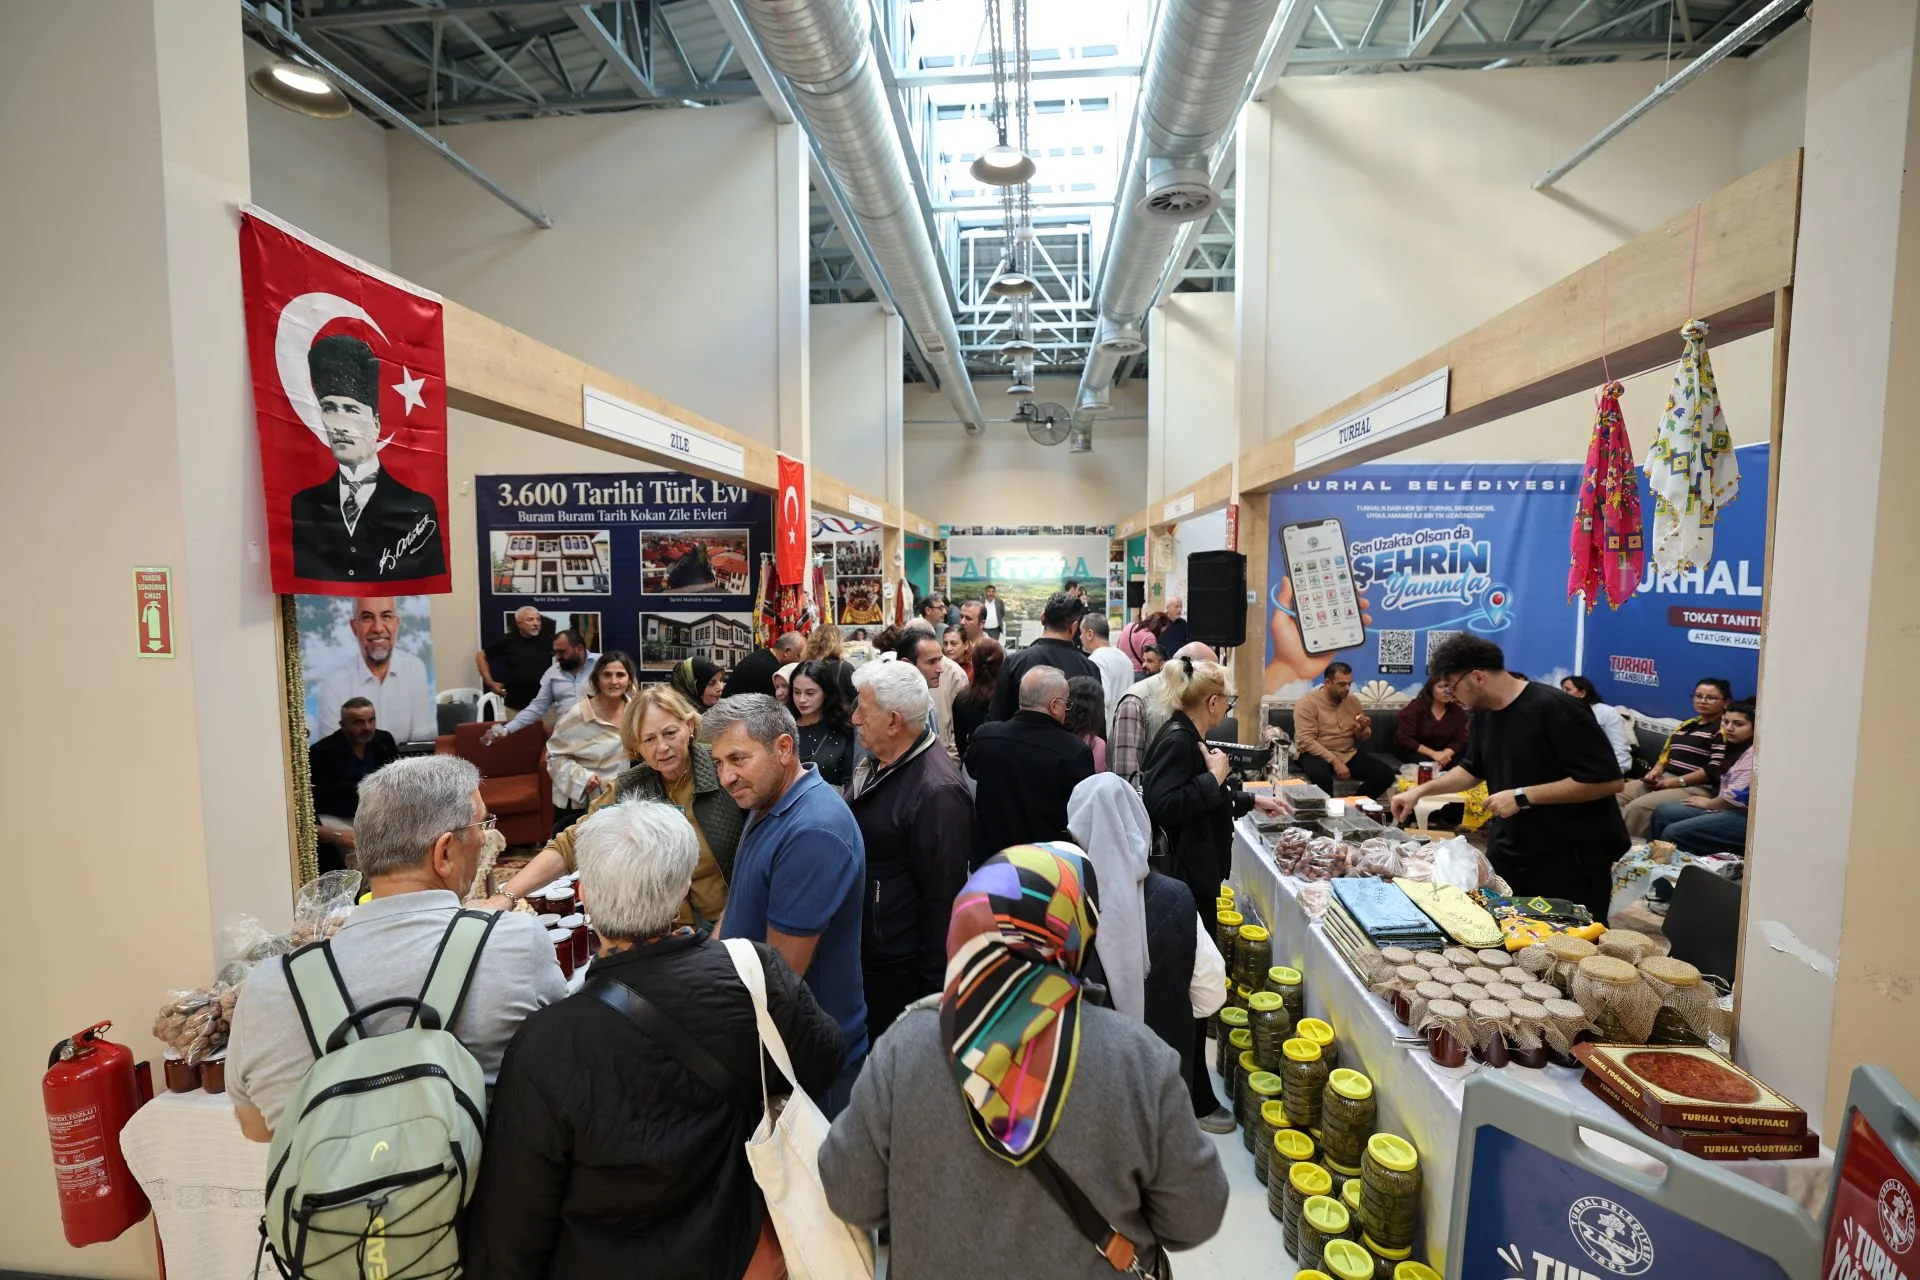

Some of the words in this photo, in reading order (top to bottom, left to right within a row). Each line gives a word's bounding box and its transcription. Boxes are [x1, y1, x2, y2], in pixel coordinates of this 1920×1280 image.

[1338, 417, 1372, 444] TURHAL
[498, 482, 567, 507] 3.600
[572, 482, 645, 505] Tarihî
[650, 479, 706, 504] Türk
[1408, 480, 1566, 491] BELEDİYESİ
[517, 510, 554, 522] Buram
[558, 510, 594, 522] Buram
[598, 510, 627, 521] Tarih
[631, 509, 666, 521] Kokan
[669, 509, 690, 520] Zile
[693, 508, 727, 520] Evleri
[1352, 544, 1372, 555] Sen
[1374, 536, 1412, 551] Uzakta
[1415, 530, 1451, 545] Olsan
[1453, 526, 1470, 540] da
[1353, 541, 1489, 588] ŞEHRİN
[1384, 569, 1486, 608] Yanında
[1683, 611, 1719, 624] TOKAT
[1694, 632, 1732, 644] ATATÜRK
[1611, 656, 1656, 675] TURHAL
[1588, 1054, 1607, 1072] TURHAL
[1606, 1069, 1641, 1098] YOĞURTMACI
[1600, 1083, 1620, 1102] TURHAL
[1621, 1099, 1659, 1132] YOĞURTMACI
[1681, 1112, 1720, 1123] TURHAL
[1723, 1112, 1789, 1128] YOĞURTMACI
[1703, 1145, 1739, 1153] TURHAL
[1741, 1142, 1802, 1153] YOĞURTMACI
[1572, 1199, 1599, 1226] TURHAL
